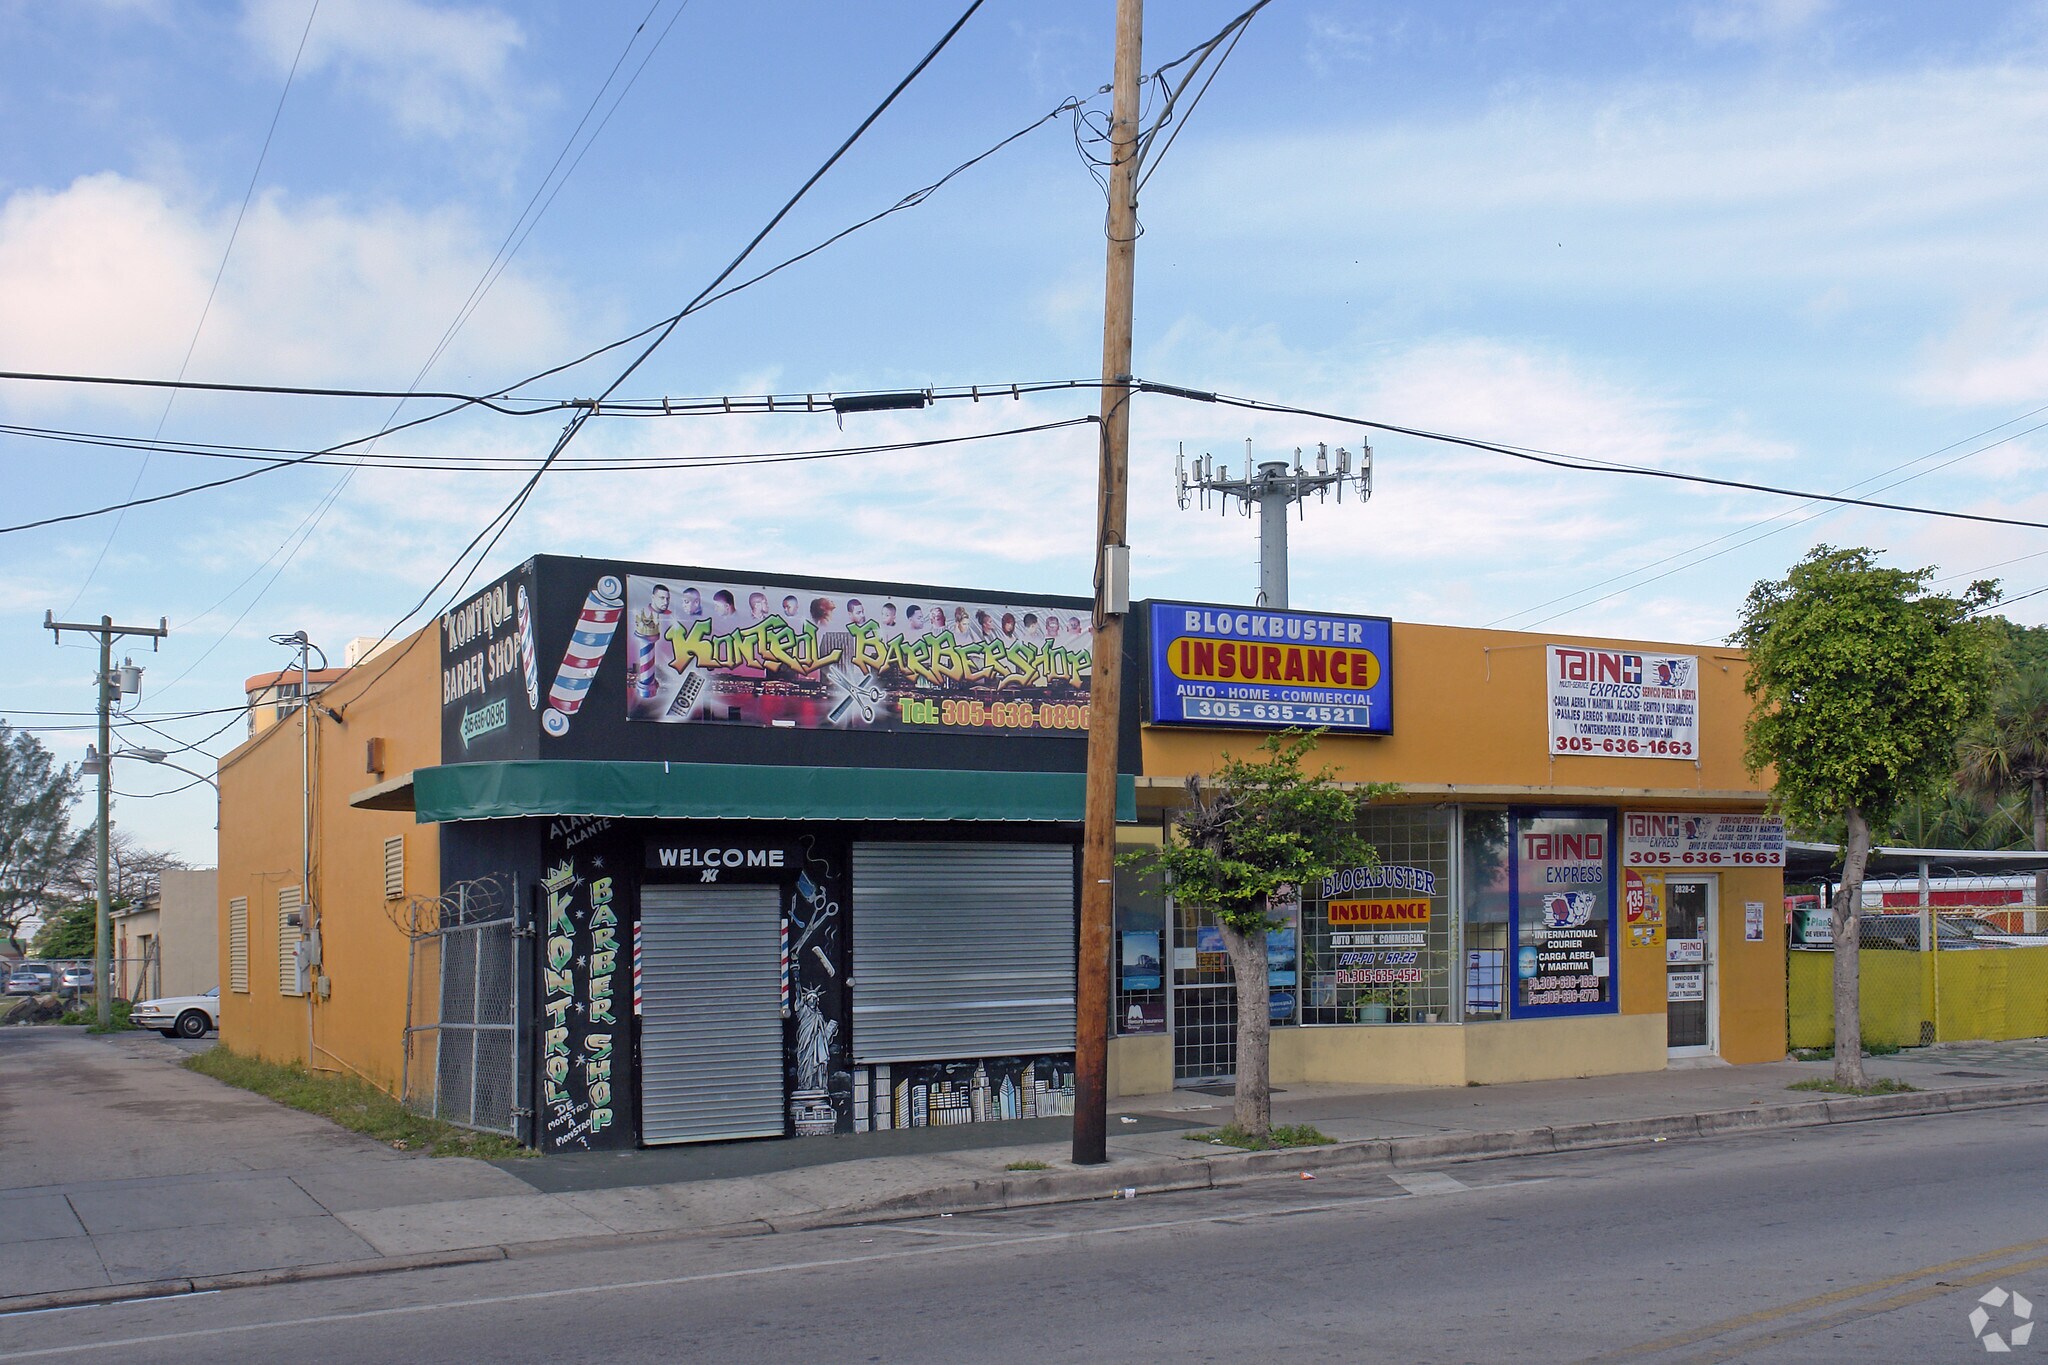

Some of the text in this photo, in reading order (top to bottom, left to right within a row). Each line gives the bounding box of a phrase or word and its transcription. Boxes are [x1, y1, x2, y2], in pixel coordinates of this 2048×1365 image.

[449, 581, 513, 652] KONTROL
[1185, 610, 1363, 644] BLOCKBUSTER
[668, 614, 841, 676] KONTROL
[444, 632, 520, 705] BARBER SHOP
[1180, 640, 1368, 686] INSURANCE
[1176, 684, 1373, 706] AUTO HOME COMMERCIAL
[1590, 683, 1641, 699] EXPRESS
[1642, 686, 1696, 700] SERVICIO PUERTA A PUERTA
[899, 698, 1090, 729] Tel: 305-636-0896
[1199, 701, 1355, 723] 305-635-4521
[1571, 697, 1586, 708] AEREA
[1588, 698, 1592, 708] Y
[1592, 698, 1614, 710] MARITIMA
[1616, 699, 1623, 710] AL
[1643, 701, 1660, 713] CENTRO
[1661, 703, 1665, 713] Y
[1666, 703, 1694, 715] SURAMERICA
[464, 703, 504, 735] 305-636-0896
[1582, 711, 1603, 722] AEREOS
[1656, 715, 1663, 725] DE
[1664, 715, 1692, 727] VEHICULOS
[1574, 723, 1578, 733] Y
[1580, 723, 1621, 736] CONTENEDORES
[1622, 726, 1627, 736] A
[1641, 727, 1673, 738] DOMINICANA
[1556, 736, 1692, 755] 305-636-1663
[1736, 825, 1752, 833] AEREA
[1754, 825, 1758, 833] Y
[1760, 825, 1783, 833] MARITIMA
[1743, 817, 1759, 825] PUERTA
[566, 817, 612, 850] ALANTE
[1650, 836, 1679, 848] EXPRESS
[1688, 842, 1700, 850] ENVIO
[1701, 842, 1707, 850] DE
[1708, 842, 1728, 850] VEHICULOS
[659, 848, 785, 867] WELCOME
[1630, 851, 1780, 864] 305-636-1663
[1322, 866, 1436, 899] BLOCKBUSTER
[1546, 866, 1603, 883] EXPRESS
[1331, 903, 1427, 921] INSURANCE
[1332, 934, 1425, 945] AUTO HOME COMMERCIAL
[1534, 929, 1598, 939] INTERNATIONAL
[590, 877, 621, 1025] BARBER
[1547, 940, 1582, 949] COURIER
[1384, 951, 1418, 964] SR-22
[1539, 951, 1595, 961] CARGA AEREA
[1539, 963, 1546, 971] Y
[1548, 962, 1589, 971] MARITIMA
[544, 891, 576, 1106] KONTROL
[585, 1033, 614, 1133] SHOP
[547, 1102, 589, 1131] MONSTRO
[554, 1100, 574, 1117] DE
[555, 1119, 591, 1147] MONSTRO
[568, 1119, 576, 1129] A
